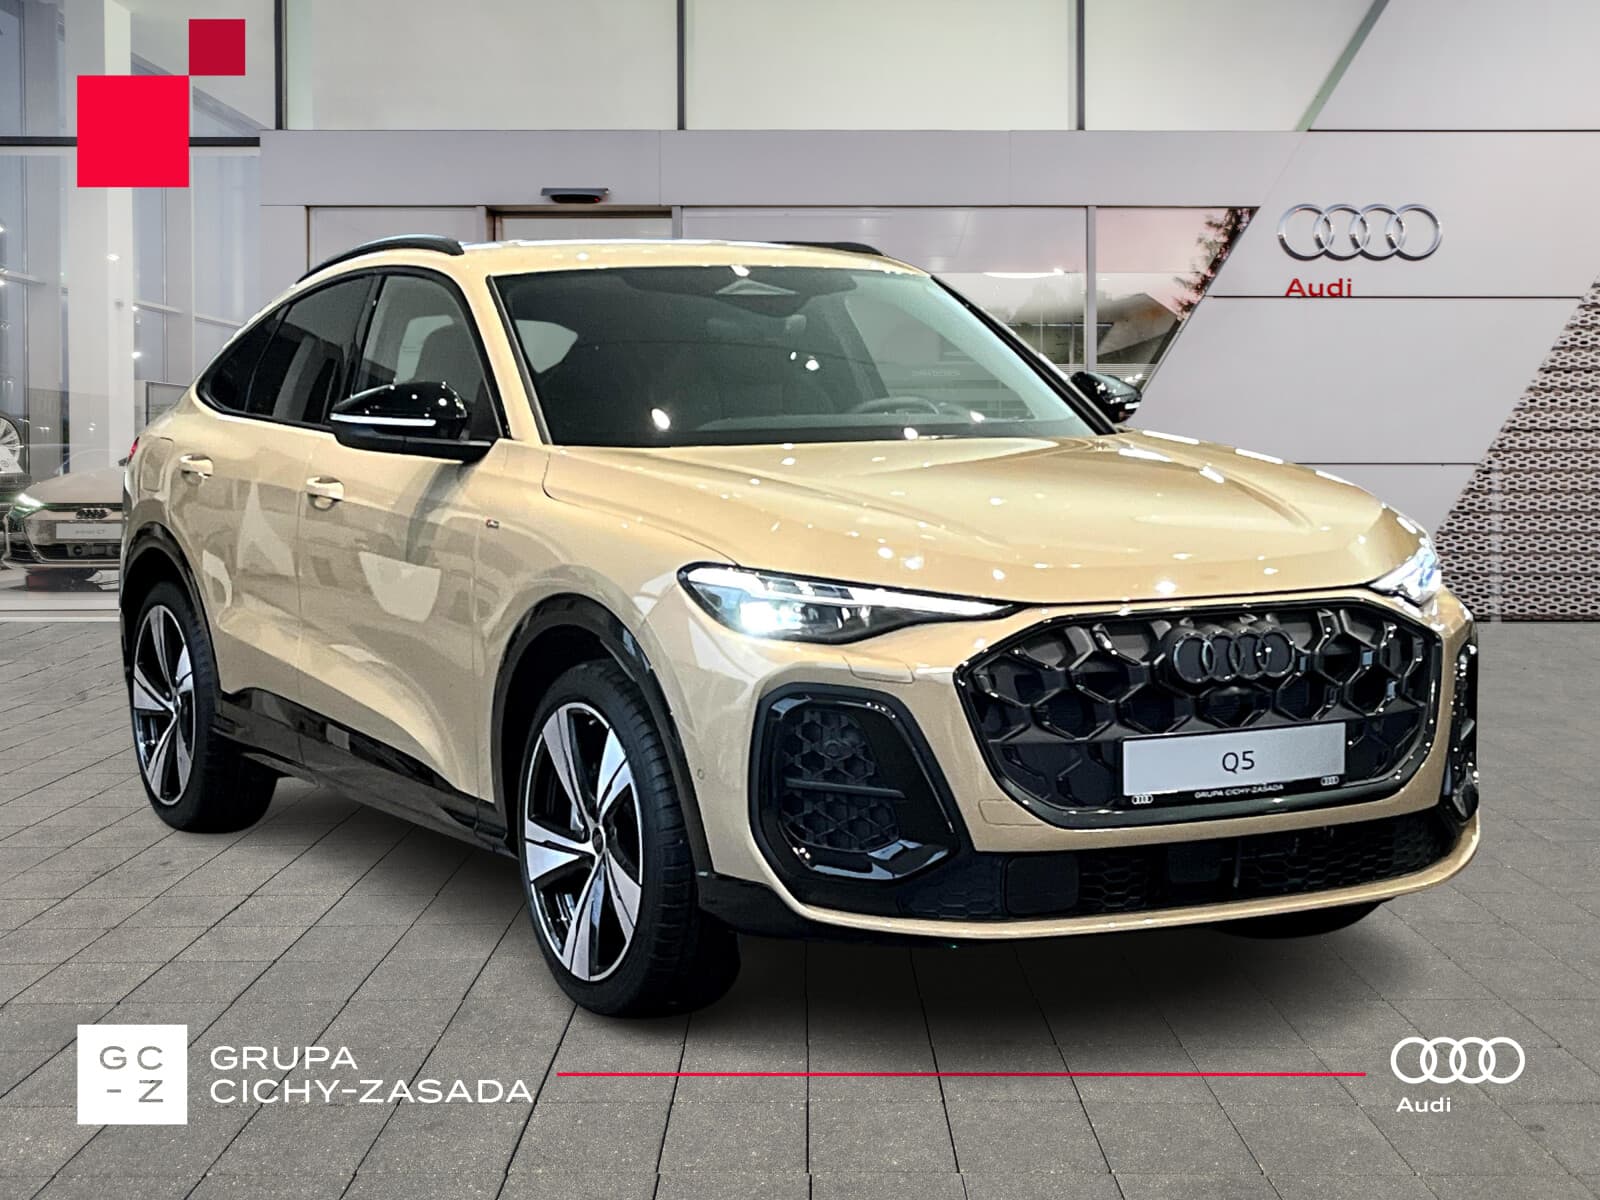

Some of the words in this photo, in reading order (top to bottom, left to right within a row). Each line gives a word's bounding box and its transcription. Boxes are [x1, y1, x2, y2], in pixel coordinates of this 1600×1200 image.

[1285, 278, 1353, 298] Audi
[1222, 750, 1255, 774] Q5
[1194, 790, 1224, 799] GRUPA
